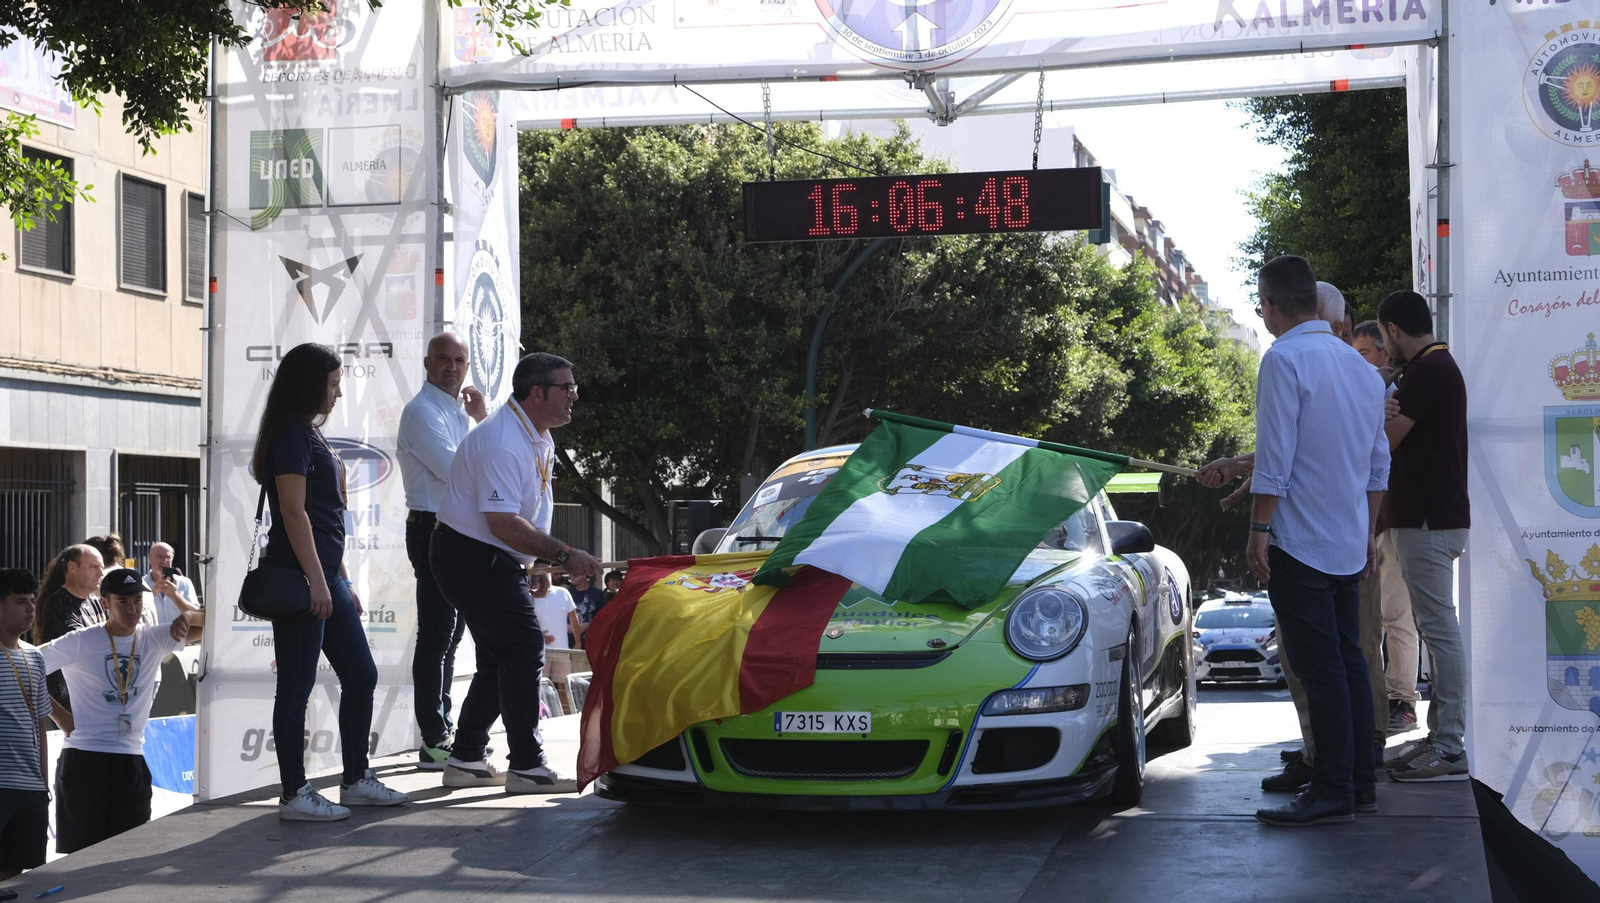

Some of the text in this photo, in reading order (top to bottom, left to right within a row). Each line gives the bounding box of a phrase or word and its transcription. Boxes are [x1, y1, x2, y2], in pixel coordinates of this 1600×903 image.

[508, 1, 656, 32] UTACIÓN
[548, 26, 653, 53] ALMERÍA
[841, 27, 853, 38] 30
[852, 35, 863, 46] de
[939, 37, 972, 55] octubre
[972, 20, 993, 38] 2023
[262, 71, 330, 84] DEPORTES
[334, 70, 351, 81] DE
[260, 158, 314, 180] UNED
[342, 158, 387, 172] ALMERÍA
[808, 176, 1030, 236] 16:06:48
[1494, 266, 1600, 287] Ayuntamient
[1508, 295, 1572, 318] Corazón
[246, 342, 393, 362] CRA
[1521, 529, 1592, 541] Ayuntamiento
[785, 714, 825, 731] 7315
[834, 714, 868, 731] KXS
[1508, 724, 1579, 735] Ayuntamiento
[1581, 724, 1594, 733] de
